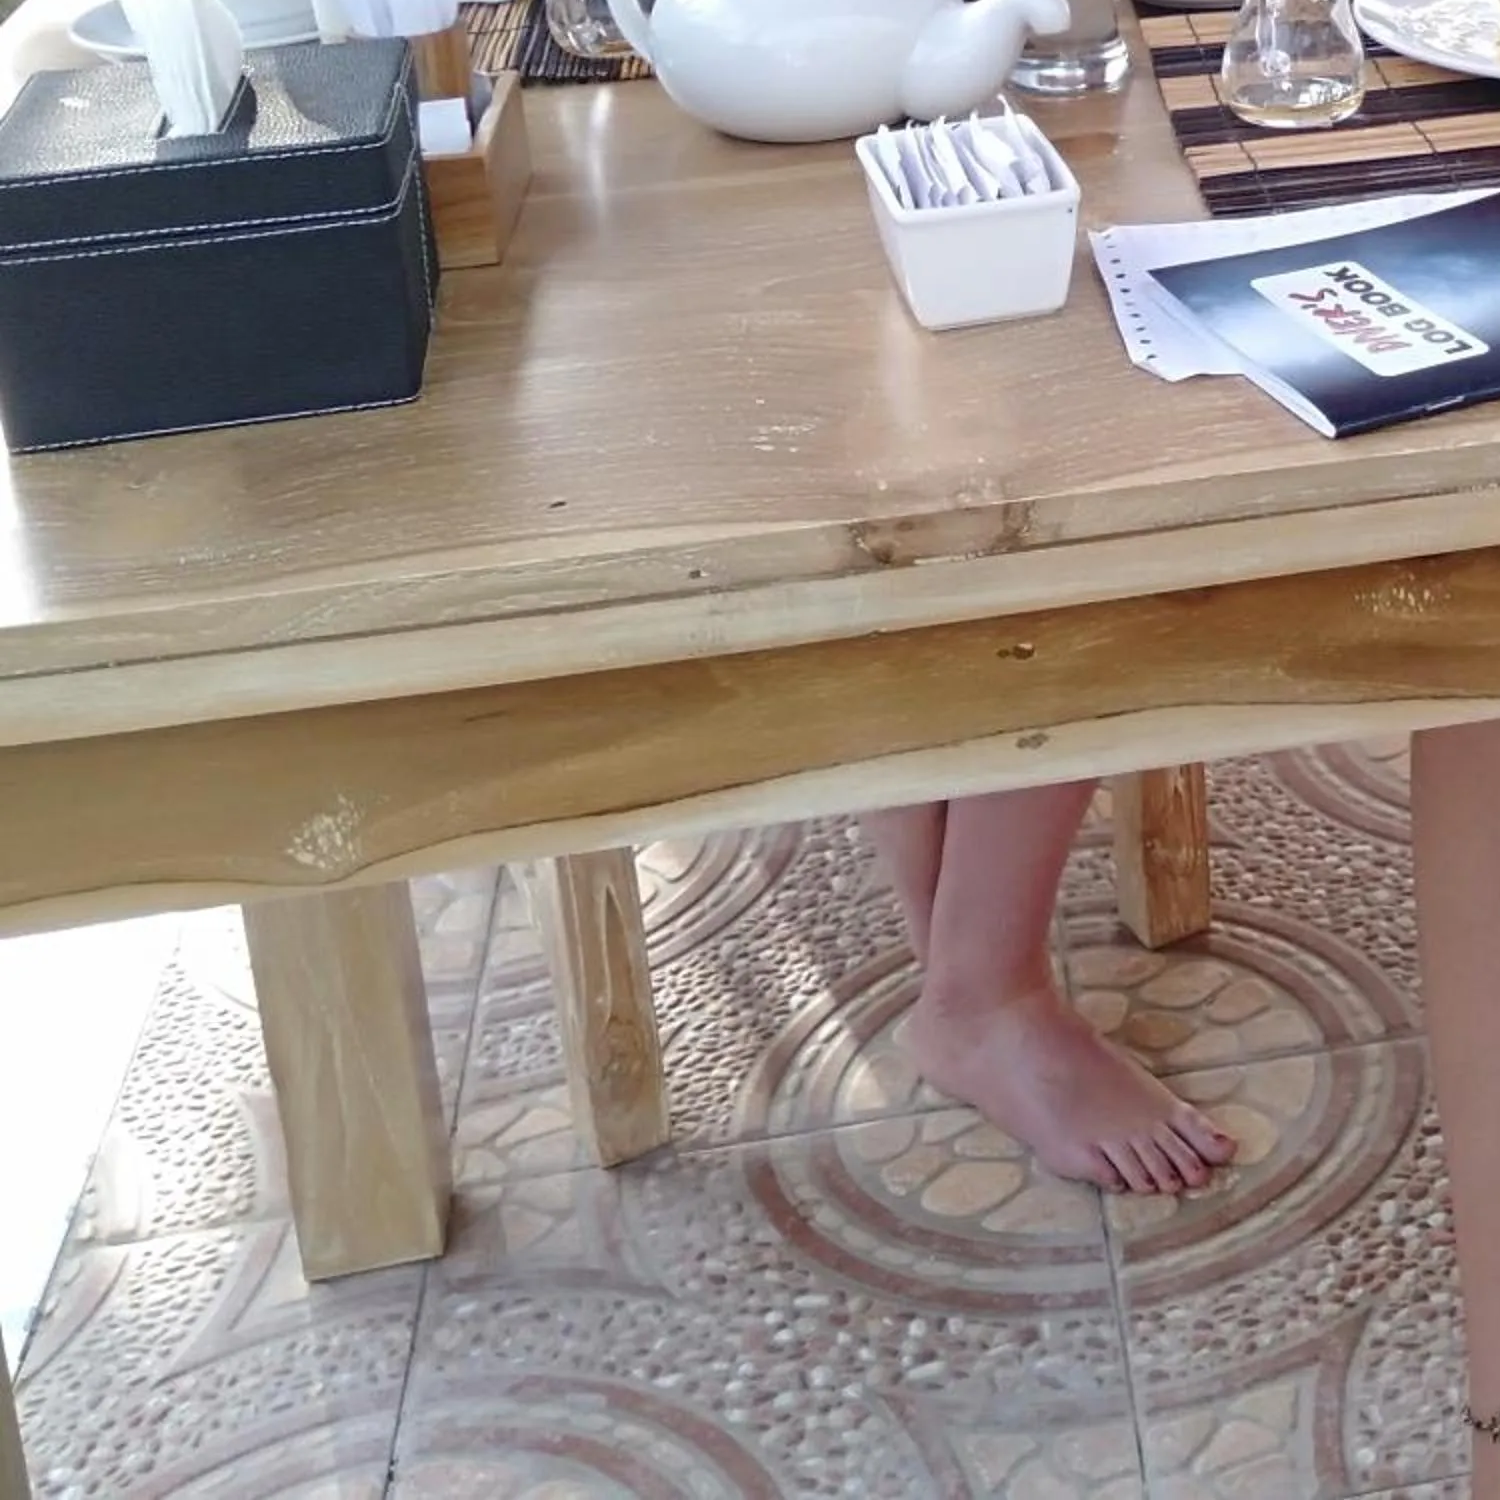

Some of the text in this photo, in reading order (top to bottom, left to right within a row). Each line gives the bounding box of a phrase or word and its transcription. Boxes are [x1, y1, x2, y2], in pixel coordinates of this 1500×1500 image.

[1288, 288, 1413, 354] DIVER'S
[1323, 266, 1473, 355] LOG BOOK
